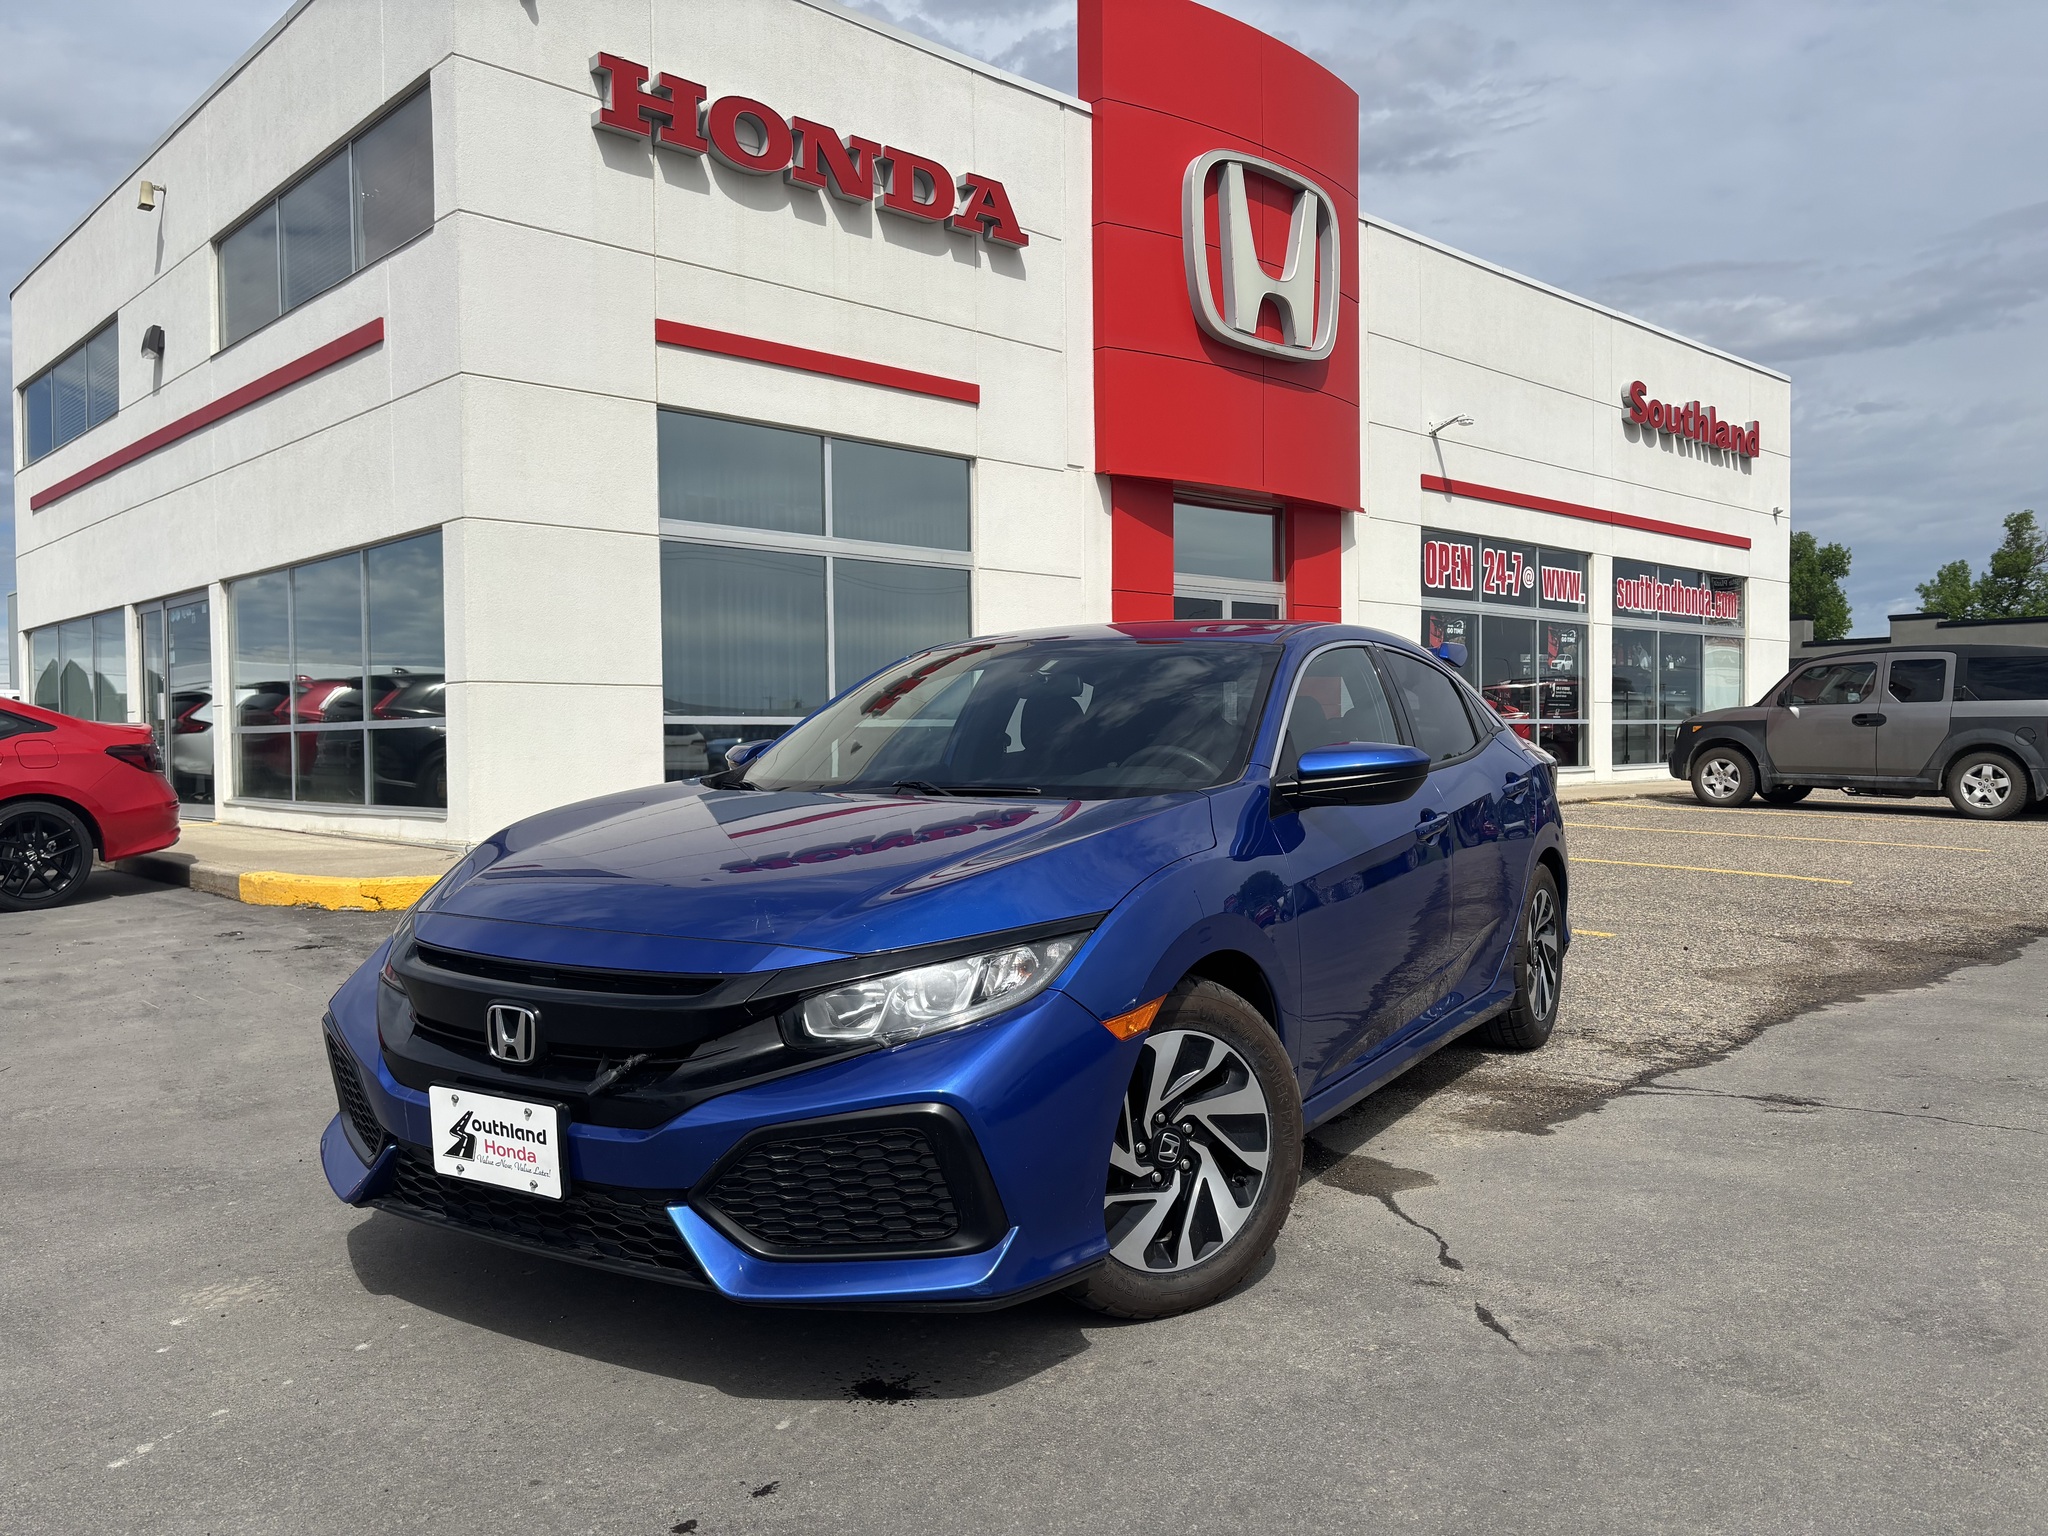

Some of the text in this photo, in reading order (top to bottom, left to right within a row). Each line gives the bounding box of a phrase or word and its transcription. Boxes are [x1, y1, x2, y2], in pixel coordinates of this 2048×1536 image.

[591, 51, 1028, 249] HONDA
[1621, 380, 1760, 458] Southland
[1424, 540, 1473, 590] OPEN
[1483, 548, 1523, 597] 24-7
[1617, 574, 1738, 619] southlandhonda.com
[1199, 1006, 1260, 1051] UNIROYAL
[476, 1154, 494, 1166] Value
[514, 1161, 532, 1174] Value
[532, 1167, 552, 1178] Later!
[484, 1138, 537, 1164] Honda
